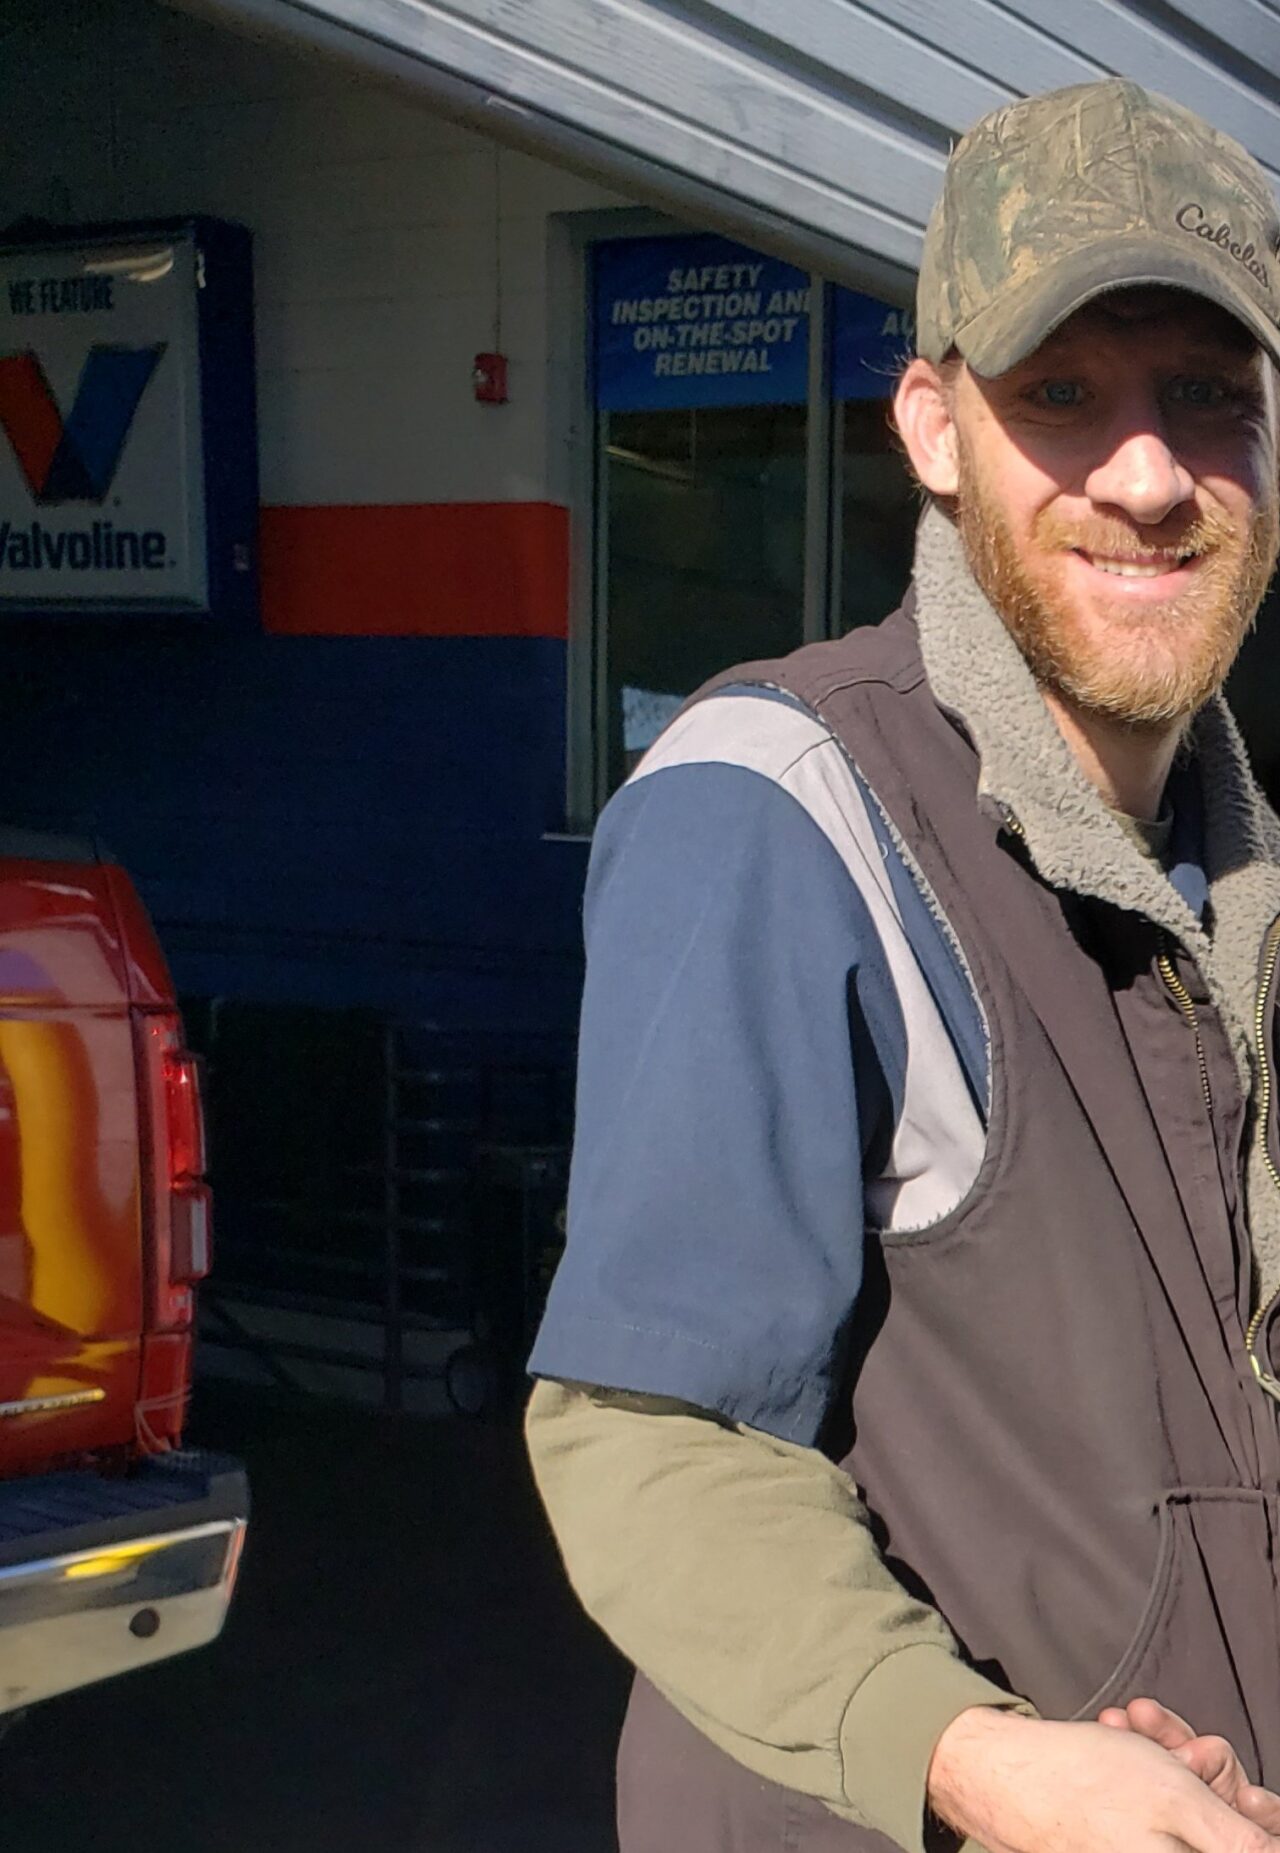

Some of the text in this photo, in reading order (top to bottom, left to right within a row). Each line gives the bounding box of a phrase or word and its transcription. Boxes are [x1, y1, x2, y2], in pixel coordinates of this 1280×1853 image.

[8, 276, 114, 315] WE FEATURE
[666, 265, 764, 293] SAFETY
[611, 291, 760, 325] INSPECTION
[632, 318, 799, 351] ON-THE-SPOT
[654, 349, 773, 377] RENEWAL
